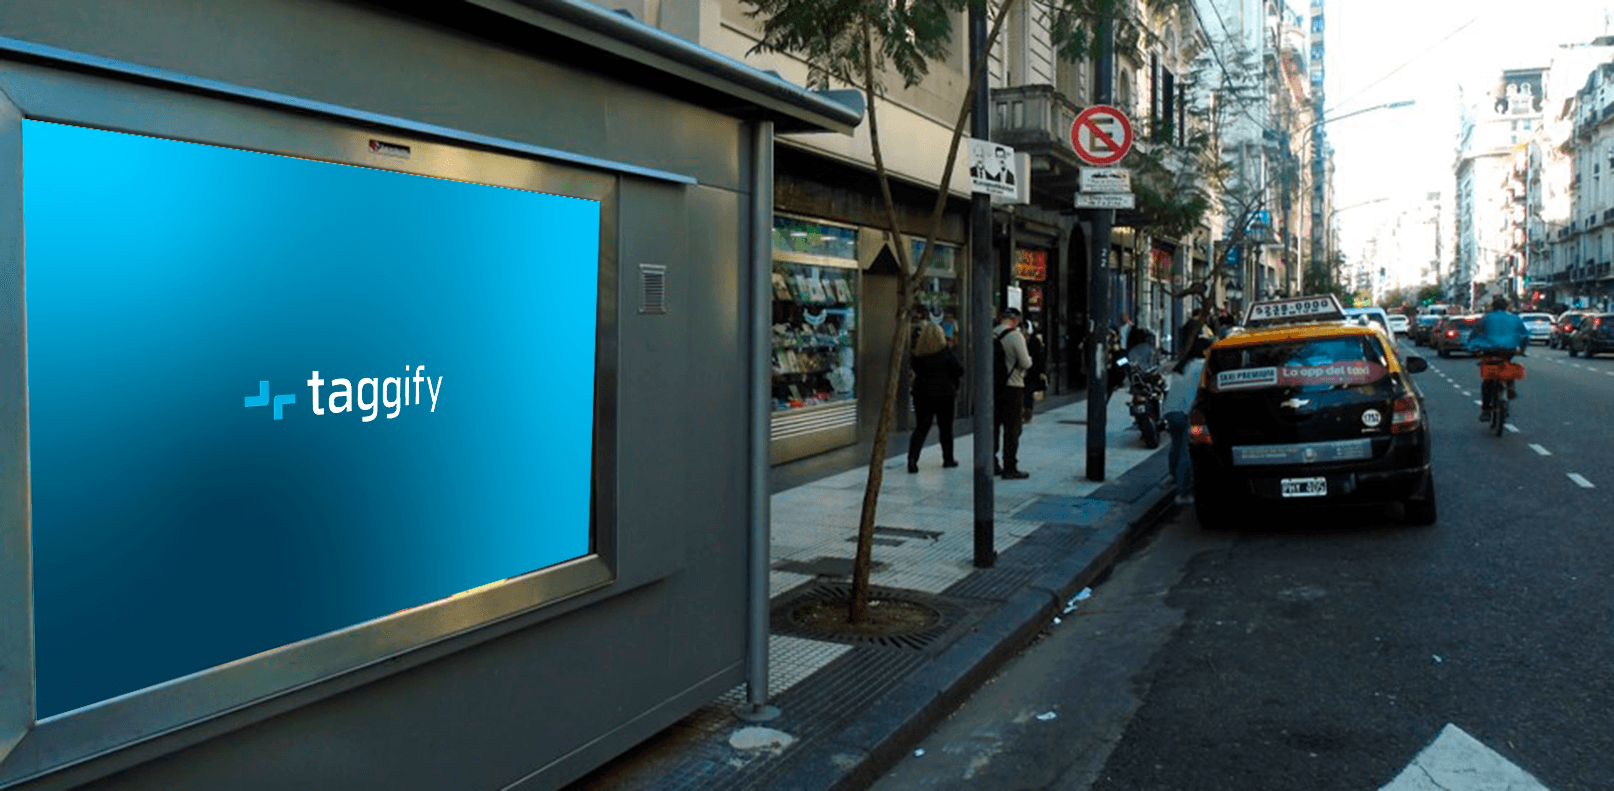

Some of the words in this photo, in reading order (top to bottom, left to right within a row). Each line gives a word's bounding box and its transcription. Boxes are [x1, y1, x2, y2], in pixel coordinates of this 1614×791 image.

[1090, 118, 1114, 152] E
[1220, 372, 1236, 381] TAXI
[1282, 368, 1298, 377] La
[1300, 367, 1323, 378] app
[1326, 365, 1345, 375] del
[1347, 364, 1370, 375] taxi
[307, 365, 443, 422] taggify
